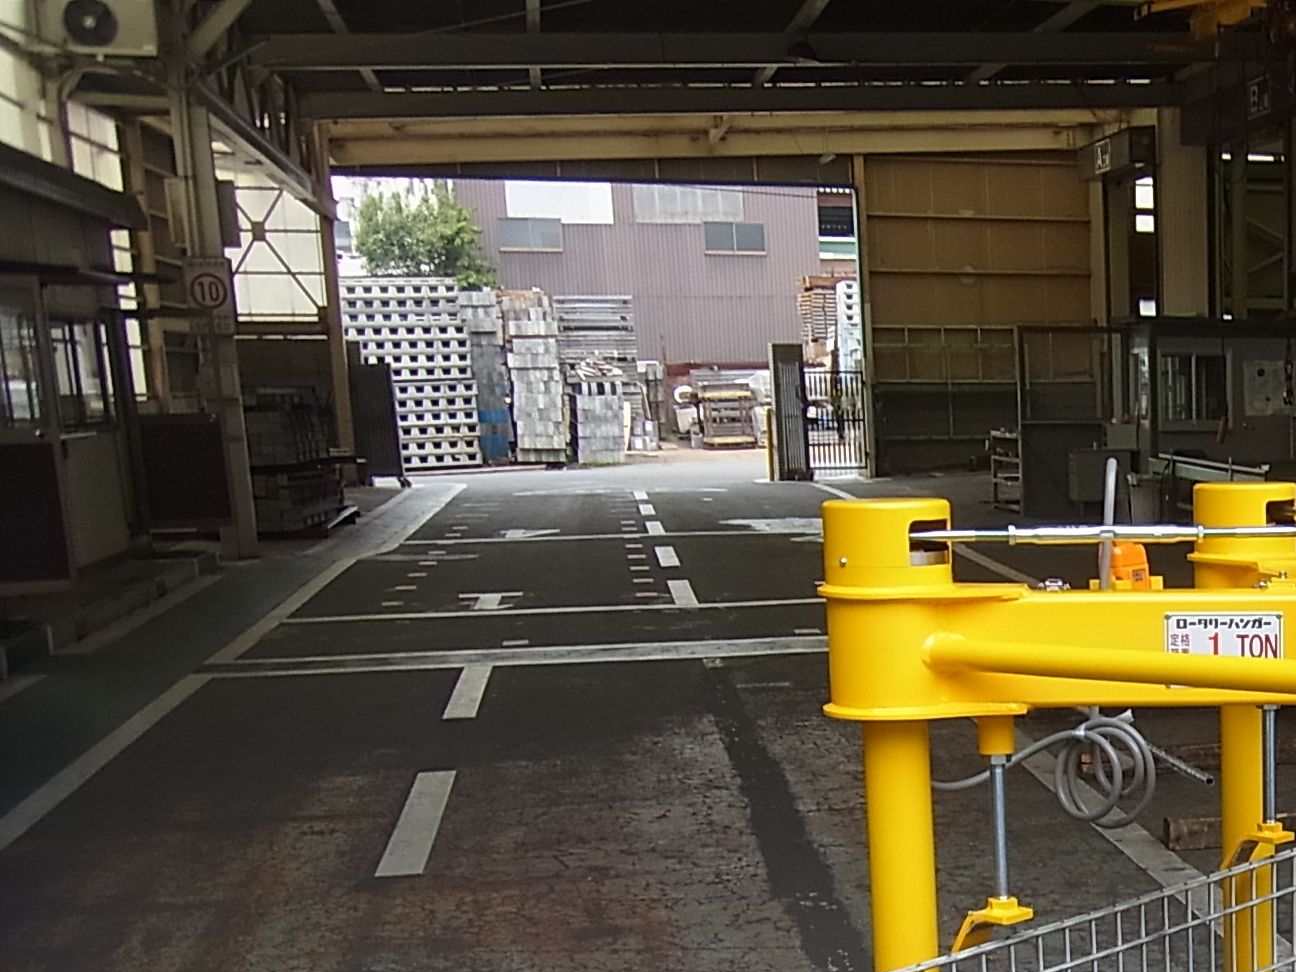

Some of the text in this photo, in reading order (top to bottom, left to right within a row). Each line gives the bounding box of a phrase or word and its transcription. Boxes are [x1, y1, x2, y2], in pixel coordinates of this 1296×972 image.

[197, 281, 220, 302] 10
[1175, 617, 1272, 630] ロータリーハンガー
[1170, 633, 1190, 647] 定格
[1208, 632, 1278, 659] 1 TON
